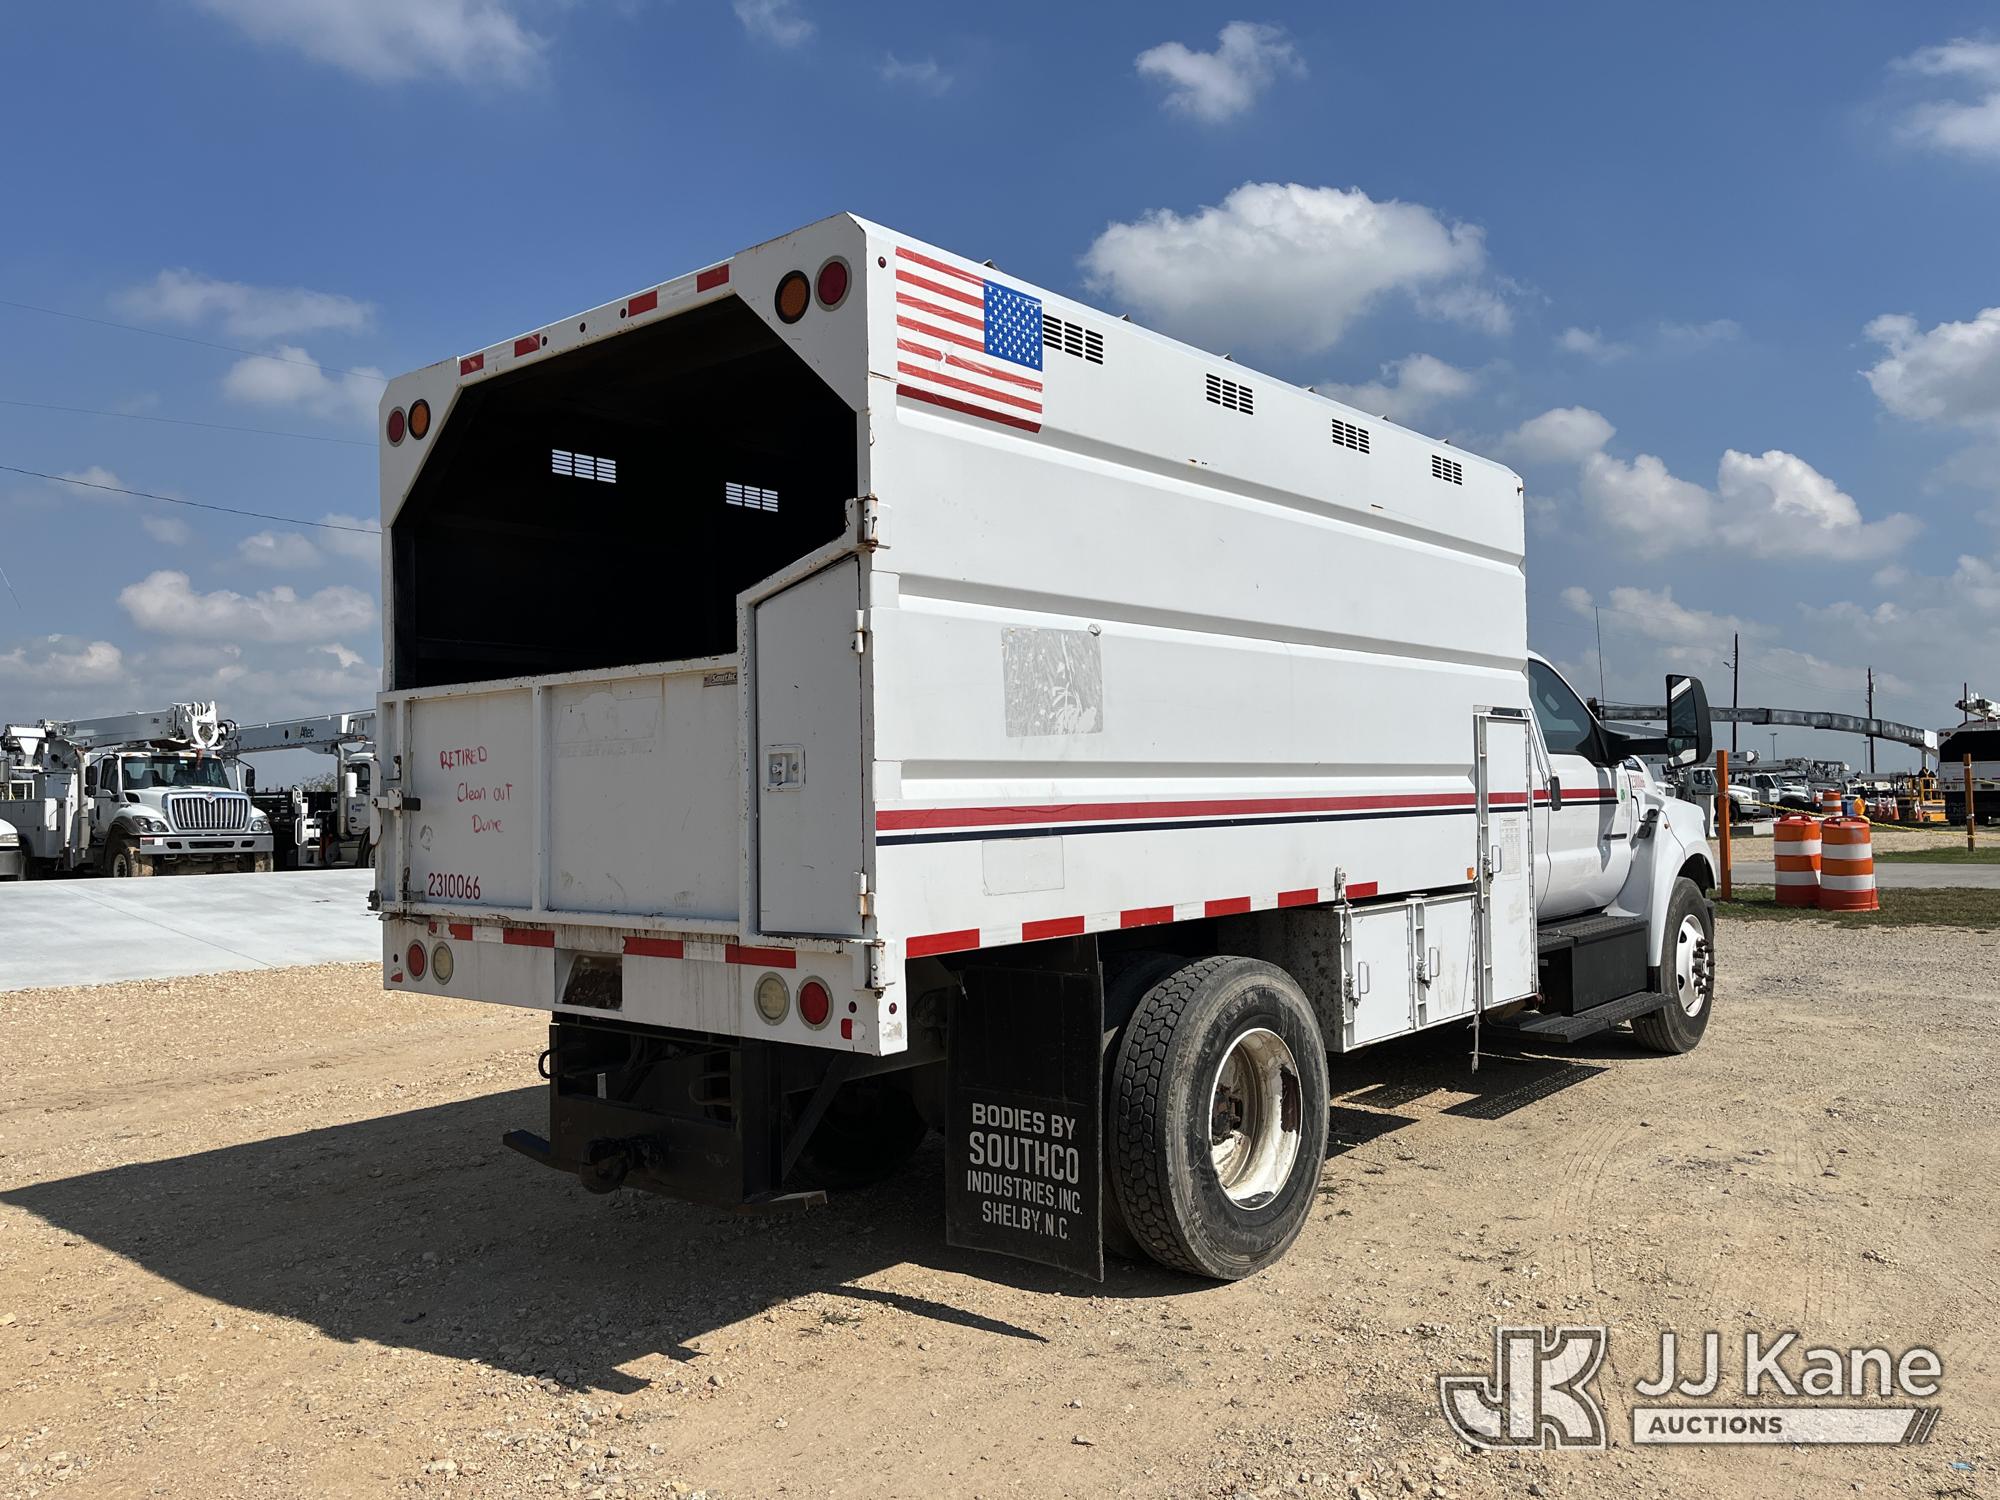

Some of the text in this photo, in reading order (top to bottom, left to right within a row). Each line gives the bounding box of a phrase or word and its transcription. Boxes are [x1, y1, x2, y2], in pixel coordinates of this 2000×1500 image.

[439, 745, 488, 770] RETIRED
[457, 782, 487, 802] Clean
[472, 814, 504, 833] Done
[428, 872, 481, 900] 2310066
[972, 1102, 1076, 1140] BODIES BY
[969, 1131, 1079, 1184] SOUTHCO
